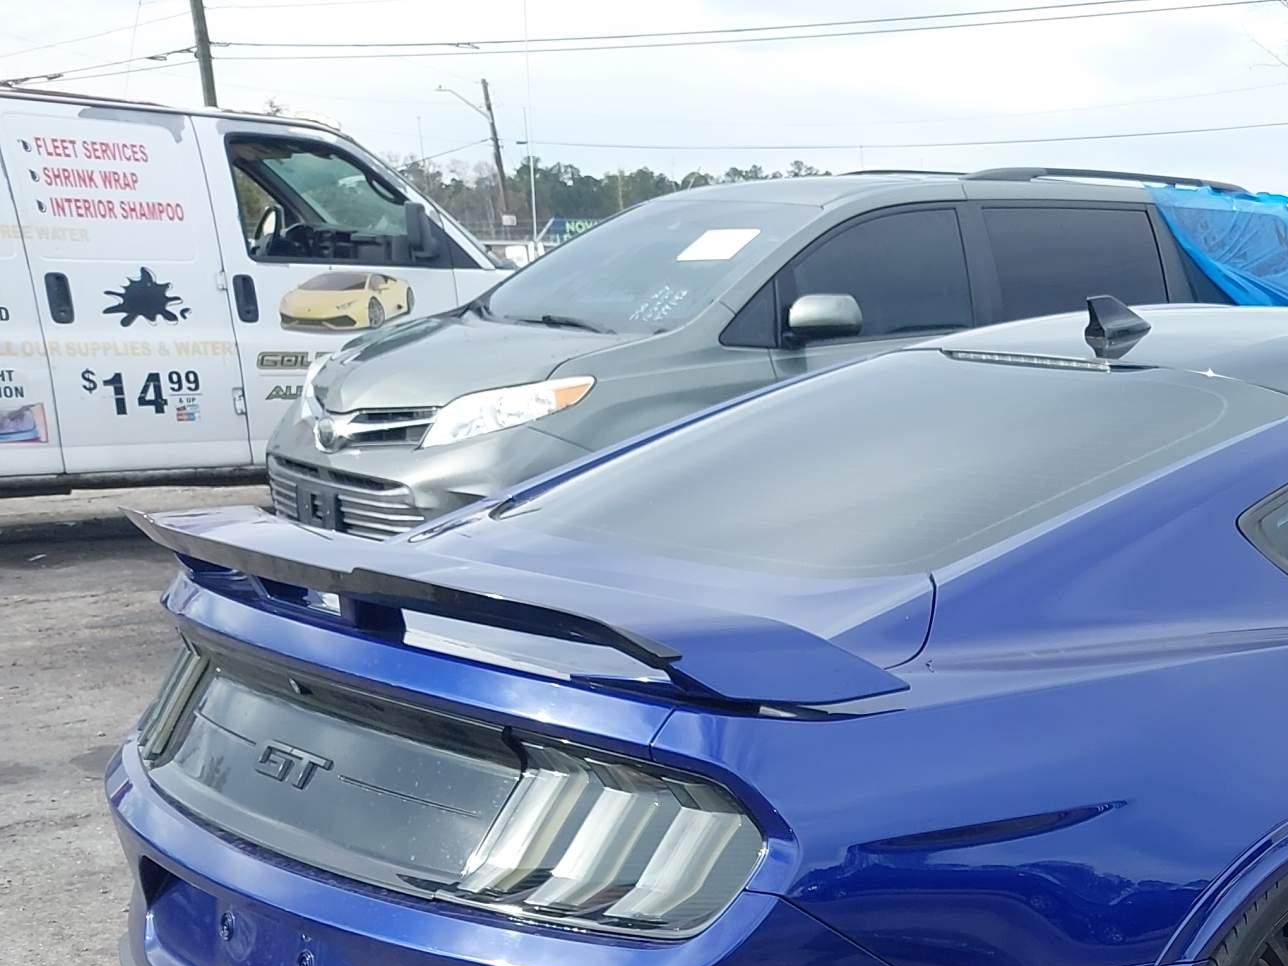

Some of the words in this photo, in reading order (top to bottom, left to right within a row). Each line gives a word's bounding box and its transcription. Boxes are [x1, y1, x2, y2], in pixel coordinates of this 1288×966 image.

[34, 137, 79, 159] FLEET
[82, 141, 148, 162] SERVICES
[43, 167, 99, 188] SHRINK
[99, 170, 139, 190] WRAP
[49, 197, 117, 219] INTERIOR
[119, 201, 184, 221] SHAMPOO
[0, 225, 34, 239] REE
[21, 340, 62, 357] OUR
[64, 341, 151, 357] SUPPLIES
[158, 341, 170, 357] &
[174, 341, 234, 358] WATER
[256, 739, 335, 791] GT
